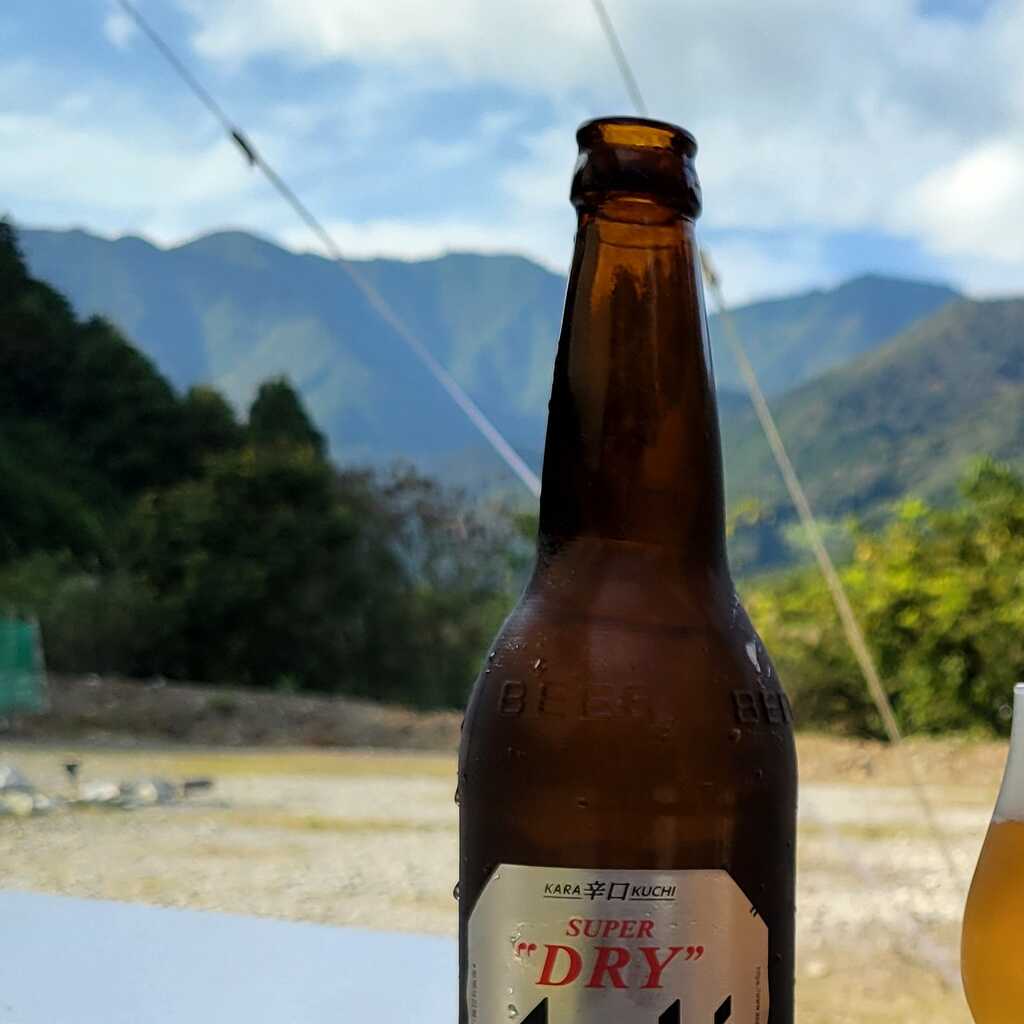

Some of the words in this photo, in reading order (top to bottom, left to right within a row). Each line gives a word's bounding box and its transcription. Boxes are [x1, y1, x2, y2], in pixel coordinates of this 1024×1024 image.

[544, 883, 581, 895] KARA
[584, 881, 630, 900] 辛口
[631, 885, 676, 897] KUCHI
[566, 919, 654, 938] SUPER
